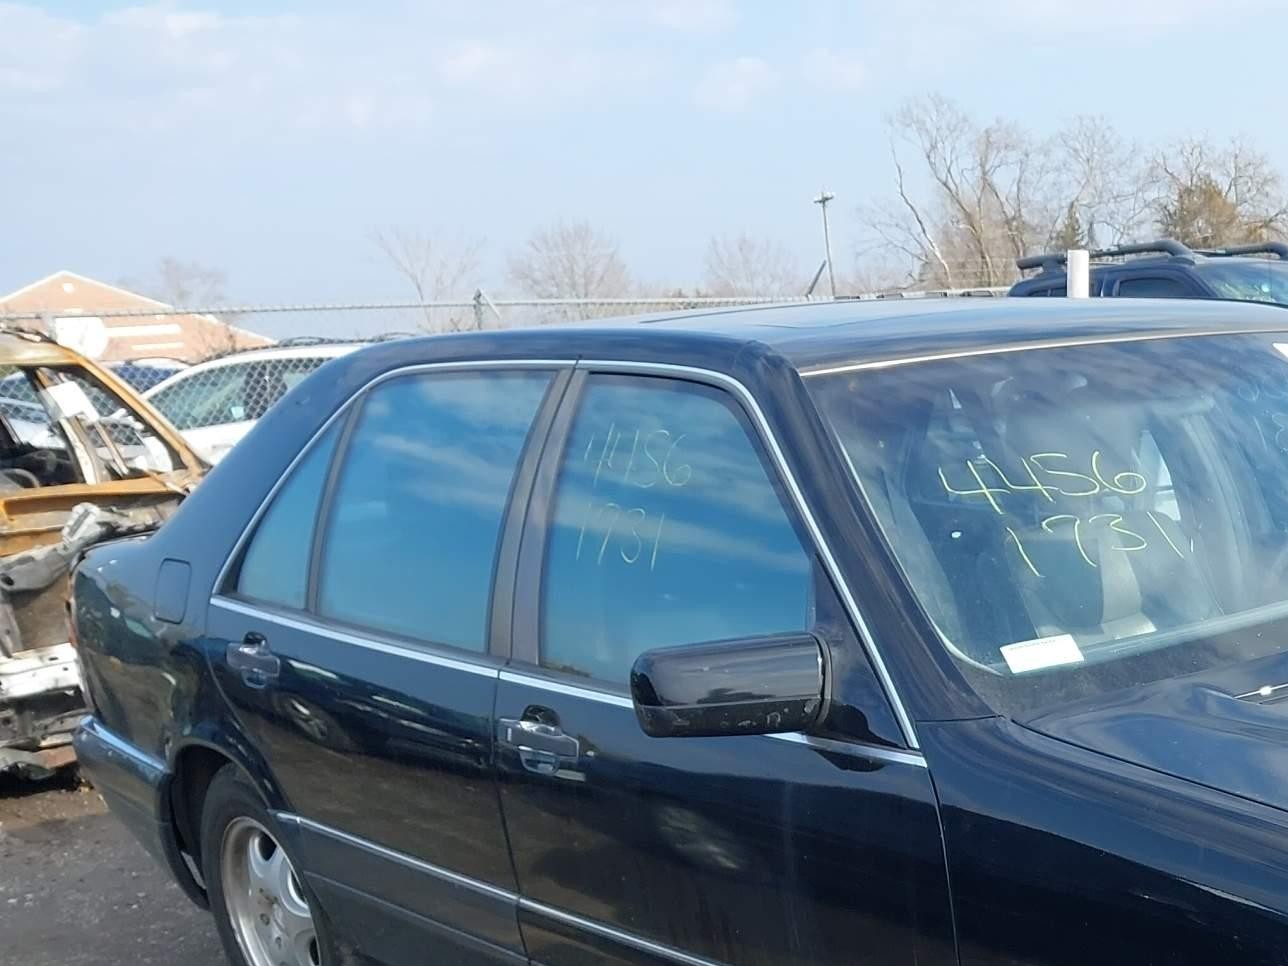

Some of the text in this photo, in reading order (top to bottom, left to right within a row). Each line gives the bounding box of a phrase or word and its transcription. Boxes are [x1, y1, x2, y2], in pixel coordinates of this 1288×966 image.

[937, 450, 1147, 515] 4456
[575, 502, 665, 572] 1731
[1006, 511, 1185, 578] 1731
